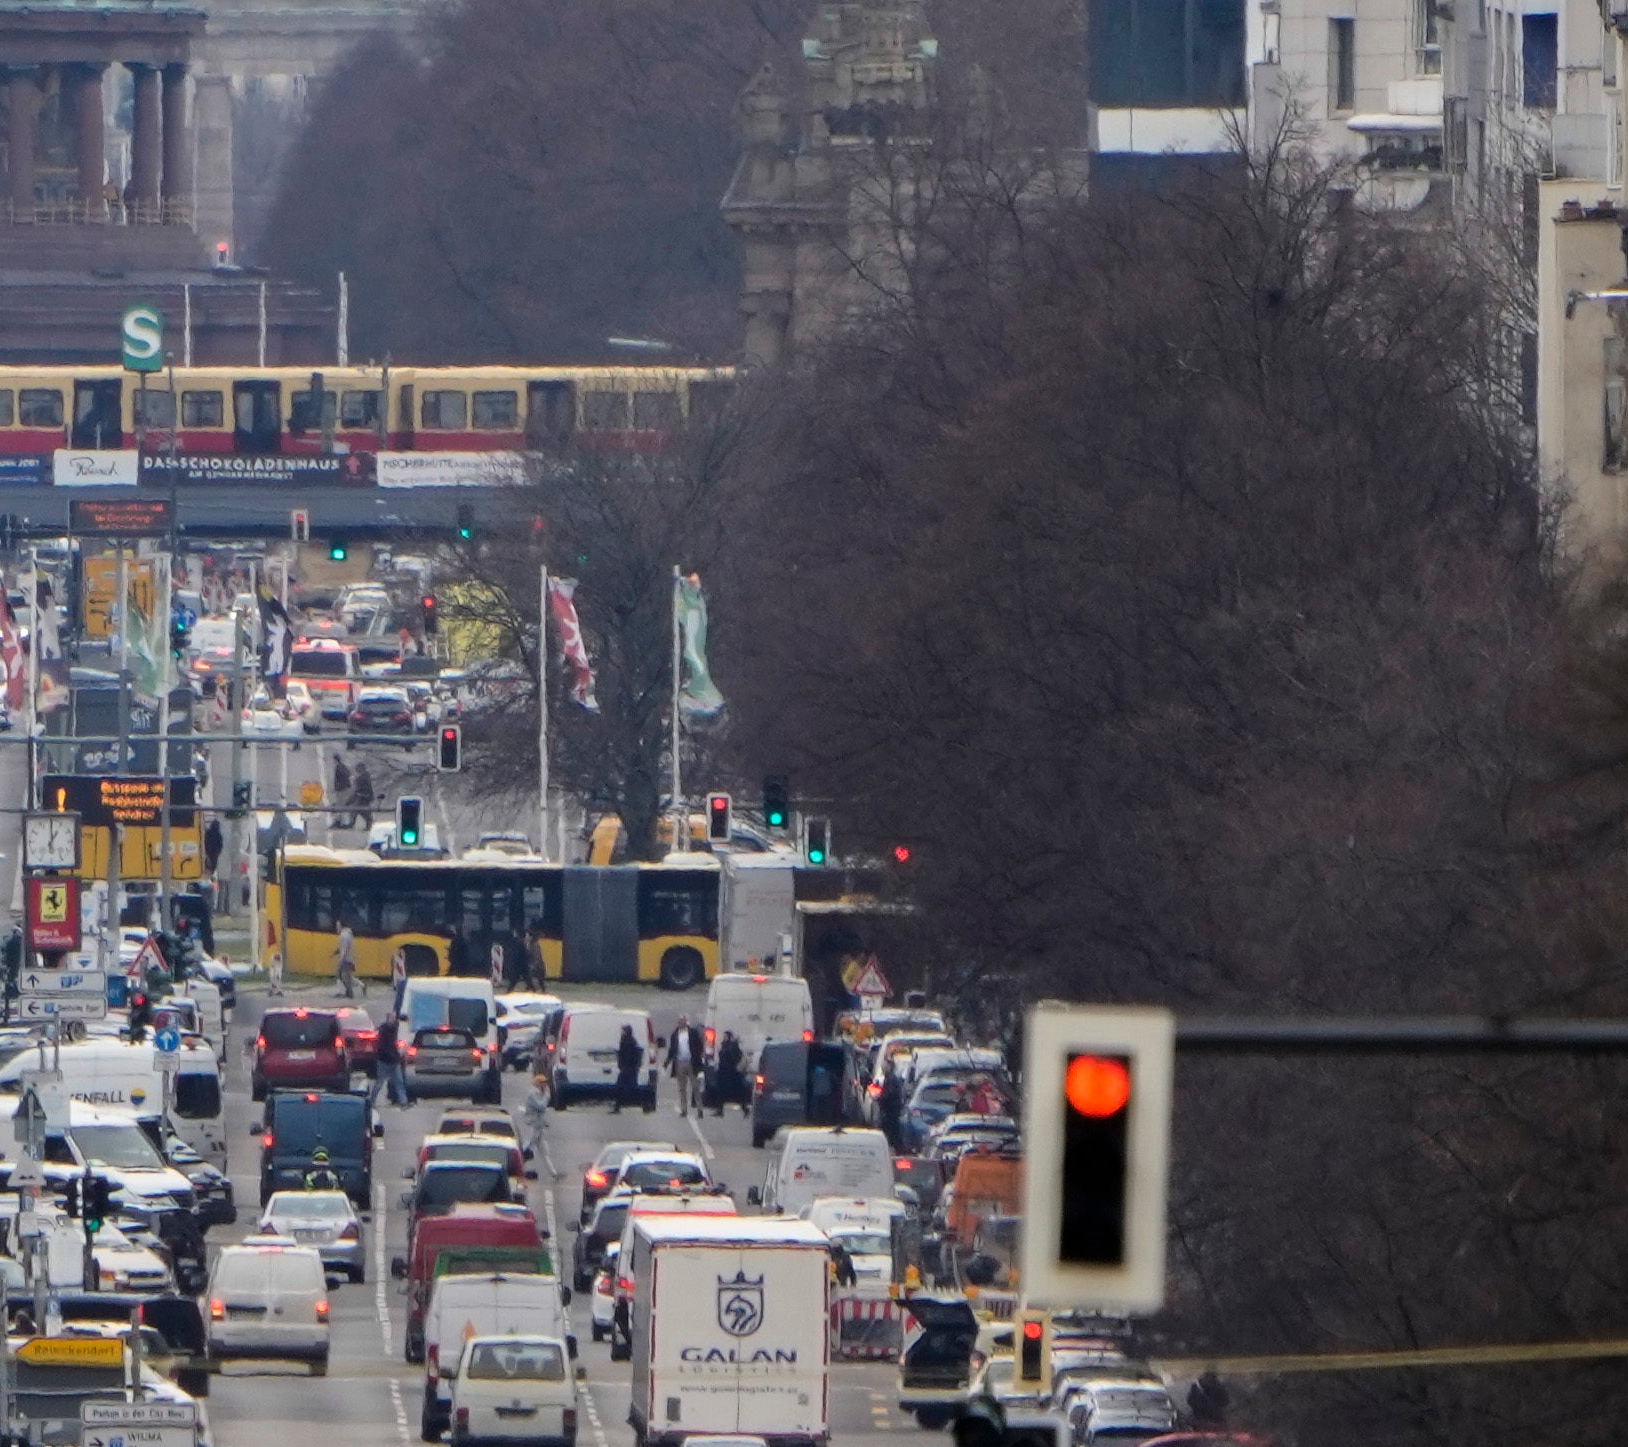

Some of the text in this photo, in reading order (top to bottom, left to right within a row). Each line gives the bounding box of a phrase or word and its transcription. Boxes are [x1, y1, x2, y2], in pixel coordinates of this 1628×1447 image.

[123, 309, 162, 358] S
[180, 457, 340, 471] SCHOKOLADENHAUS
[33, 1343, 115, 1356] Reinickendorf
[681, 1346, 798, 1363] GALAN
[126, 1431, 163, 1443] WILMA
